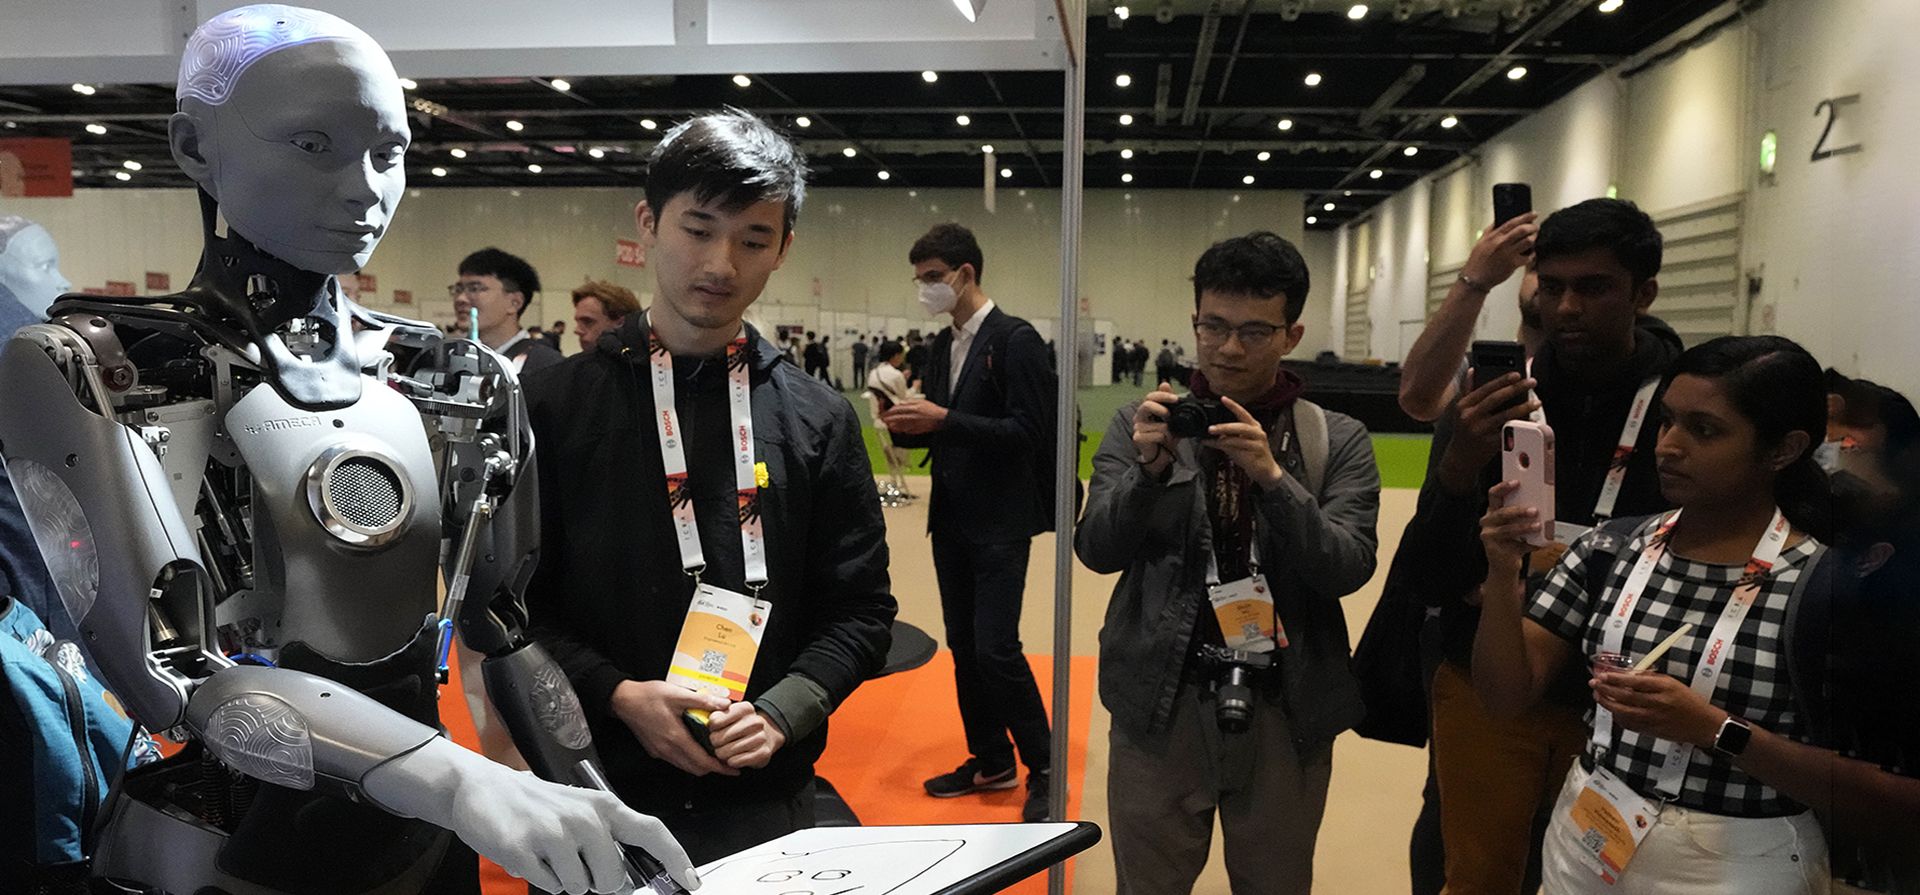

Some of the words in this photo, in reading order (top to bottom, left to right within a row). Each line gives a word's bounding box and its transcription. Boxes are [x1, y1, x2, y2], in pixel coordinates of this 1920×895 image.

[662, 410, 674, 436] BOSCH
[738, 425, 748, 452] BOSCH
[1618, 593, 1633, 618] BOSCH
[1707, 639, 1723, 665] BOSCH
